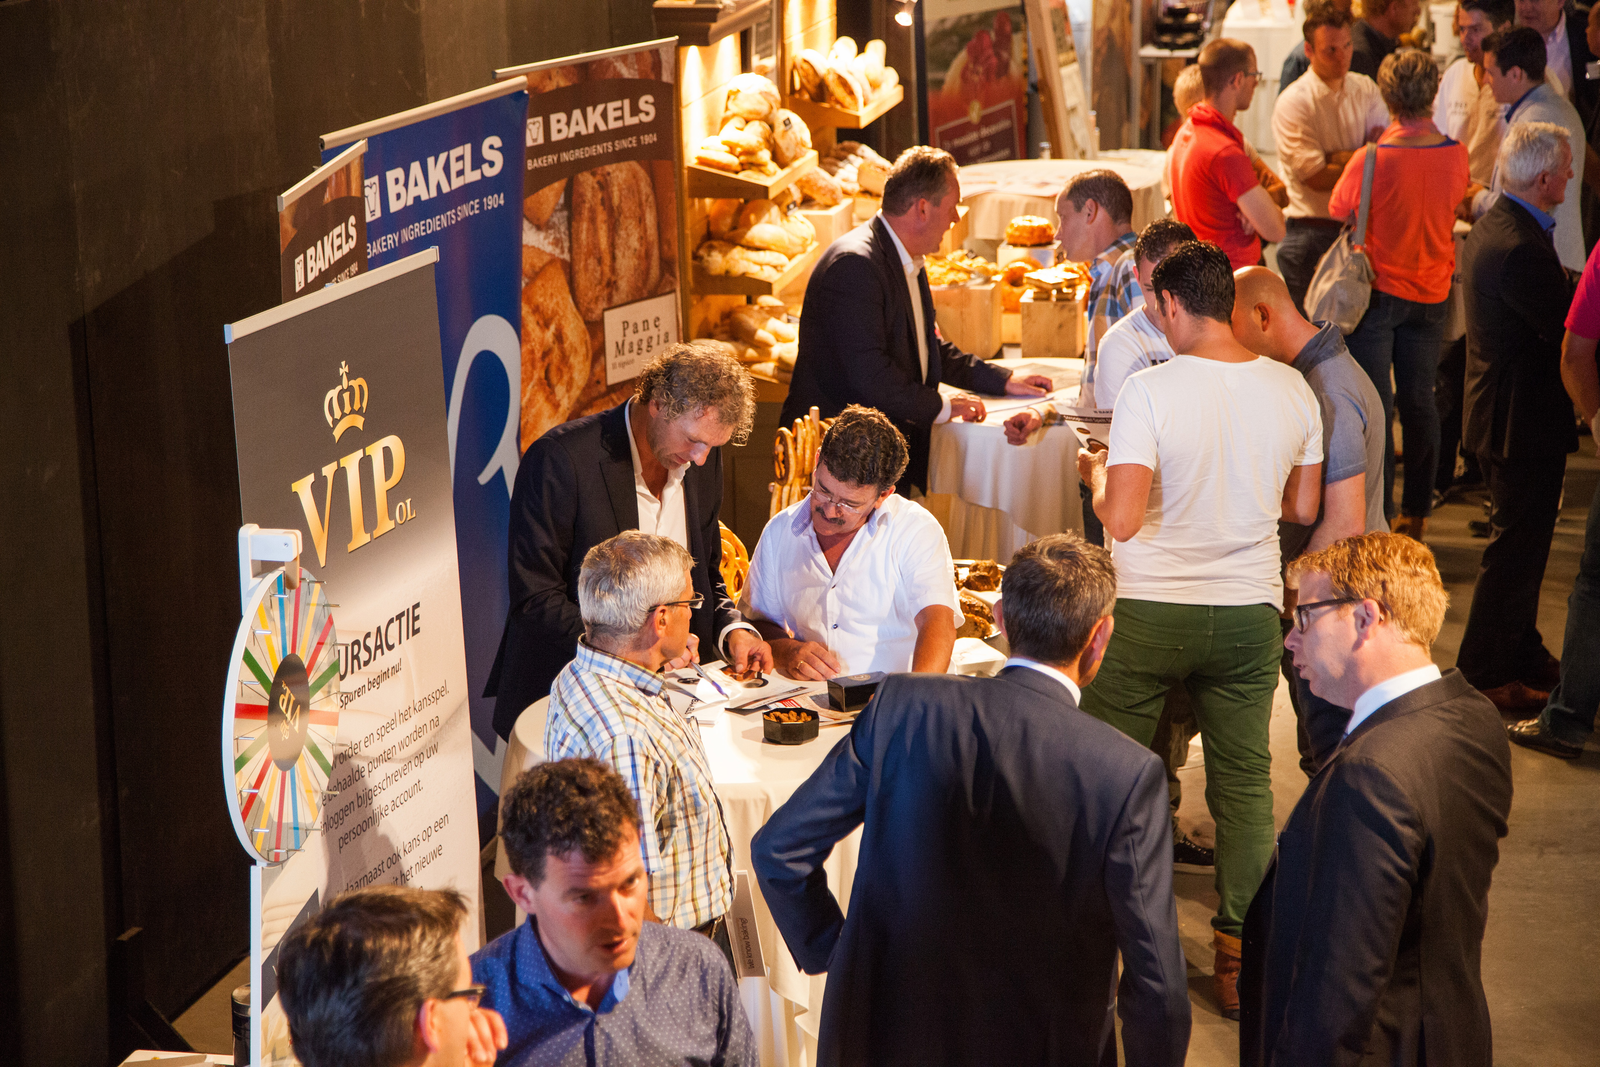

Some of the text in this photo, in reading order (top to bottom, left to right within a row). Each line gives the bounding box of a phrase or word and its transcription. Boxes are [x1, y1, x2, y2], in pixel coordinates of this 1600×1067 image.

[527, 133, 658, 170] BAKERY INGREDIENTS SINCE 1904
[550, 94, 656, 142] BAKELS
[386, 135, 504, 213] BAKELS
[306, 215, 357, 283] BAKELS
[367, 192, 505, 259] BAKERY INGREDIENTS SINCE 1904
[615, 328, 669, 358] Maggia
[622, 316, 660, 337] Pane
[291, 434, 416, 569] VIP OL
[368, 667, 390, 690] begint
[391, 658, 402, 677] nu!
[339, 740, 362, 765] order
[364, 732, 374, 748] en
[377, 712, 397, 742] speel
[399, 705, 412, 725] het
[413, 679, 449, 716] kansspel.
[320, 800, 355, 837] inloggen
[356, 761, 412, 808] bijgeschreven
[414, 751, 424, 768] op
[426, 742, 438, 759] uw
[327, 764, 365, 801] behaalde
[367, 745, 397, 777] punten
[398, 725, 427, 752] worden
[429, 716, 440, 731] na
[338, 779, 423, 854] persoonlijke account.
[344, 814, 449, 896] daarnaast ook kans op een
[400, 865, 413, 886] het
[415, 844, 443, 874] nieuwe
